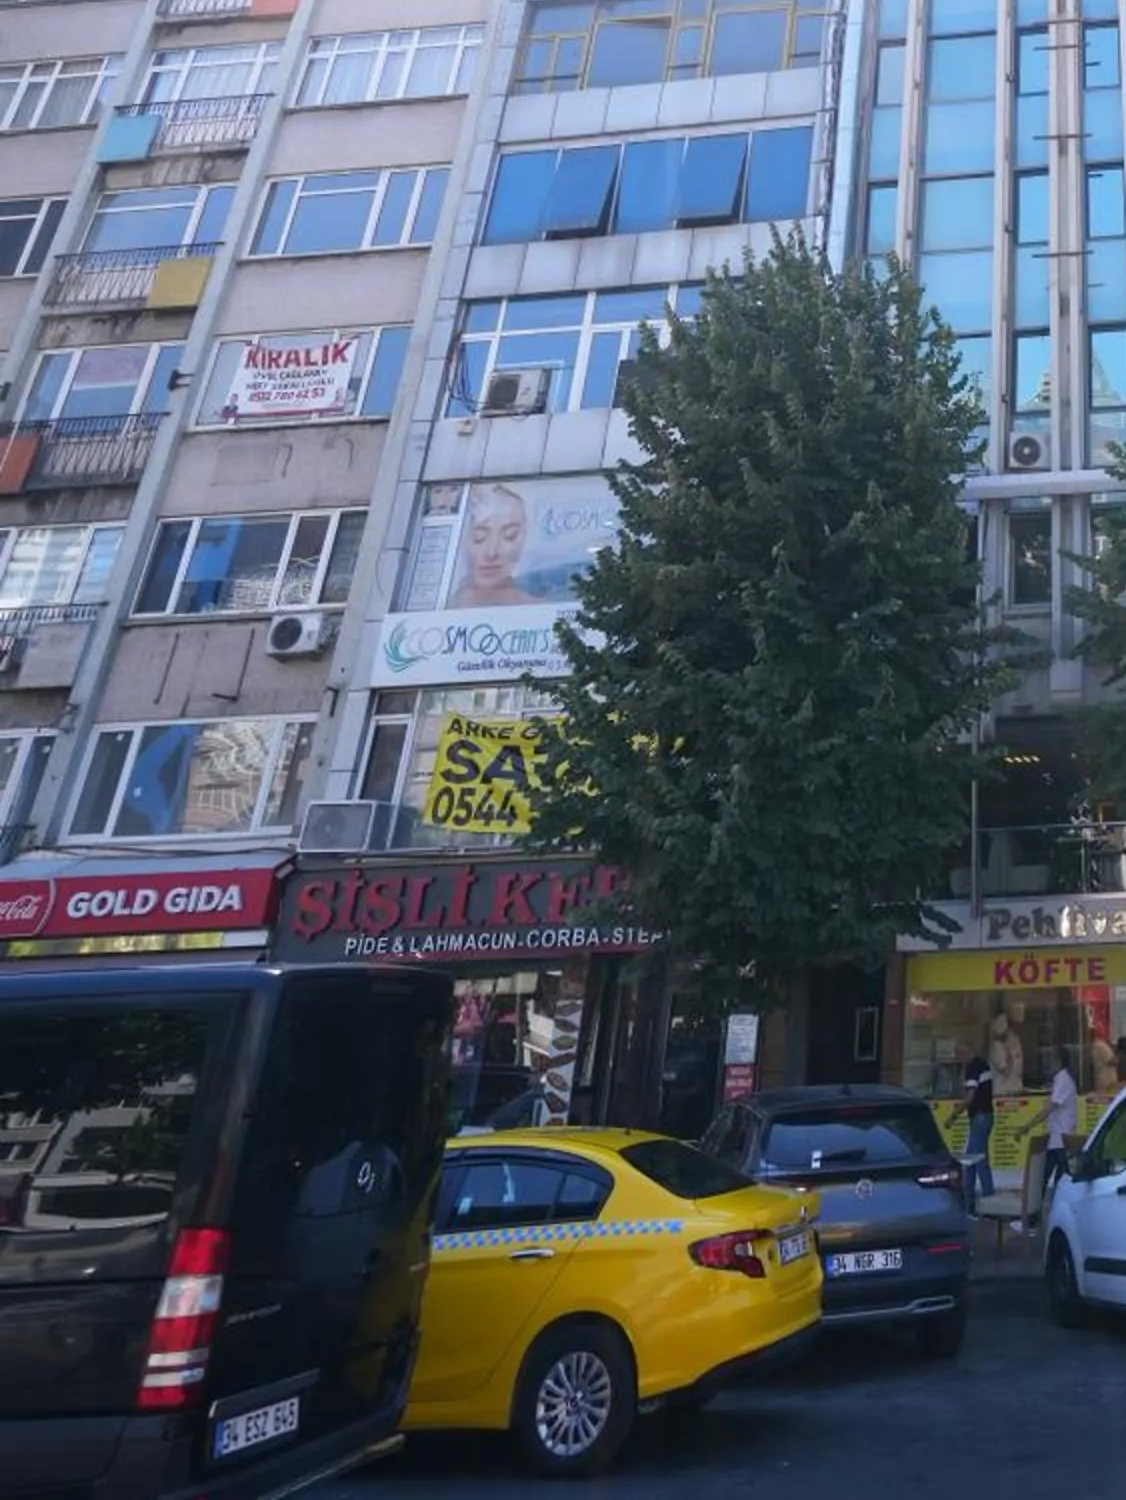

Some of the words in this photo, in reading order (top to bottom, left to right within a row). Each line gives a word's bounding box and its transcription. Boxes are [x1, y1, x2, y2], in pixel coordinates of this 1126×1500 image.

[431, 785, 518, 827] 0544
[66, 888, 158, 919] GOLD
[163, 884, 243, 913] GIDA
[291, 861, 478, 941] ŞİŞLİ
[344, 932, 390, 956] PİDE
[391, 936, 404, 953] &
[994, 952, 1107, 986] KÖFTE
[245, 1409, 270, 1443] ESZ
